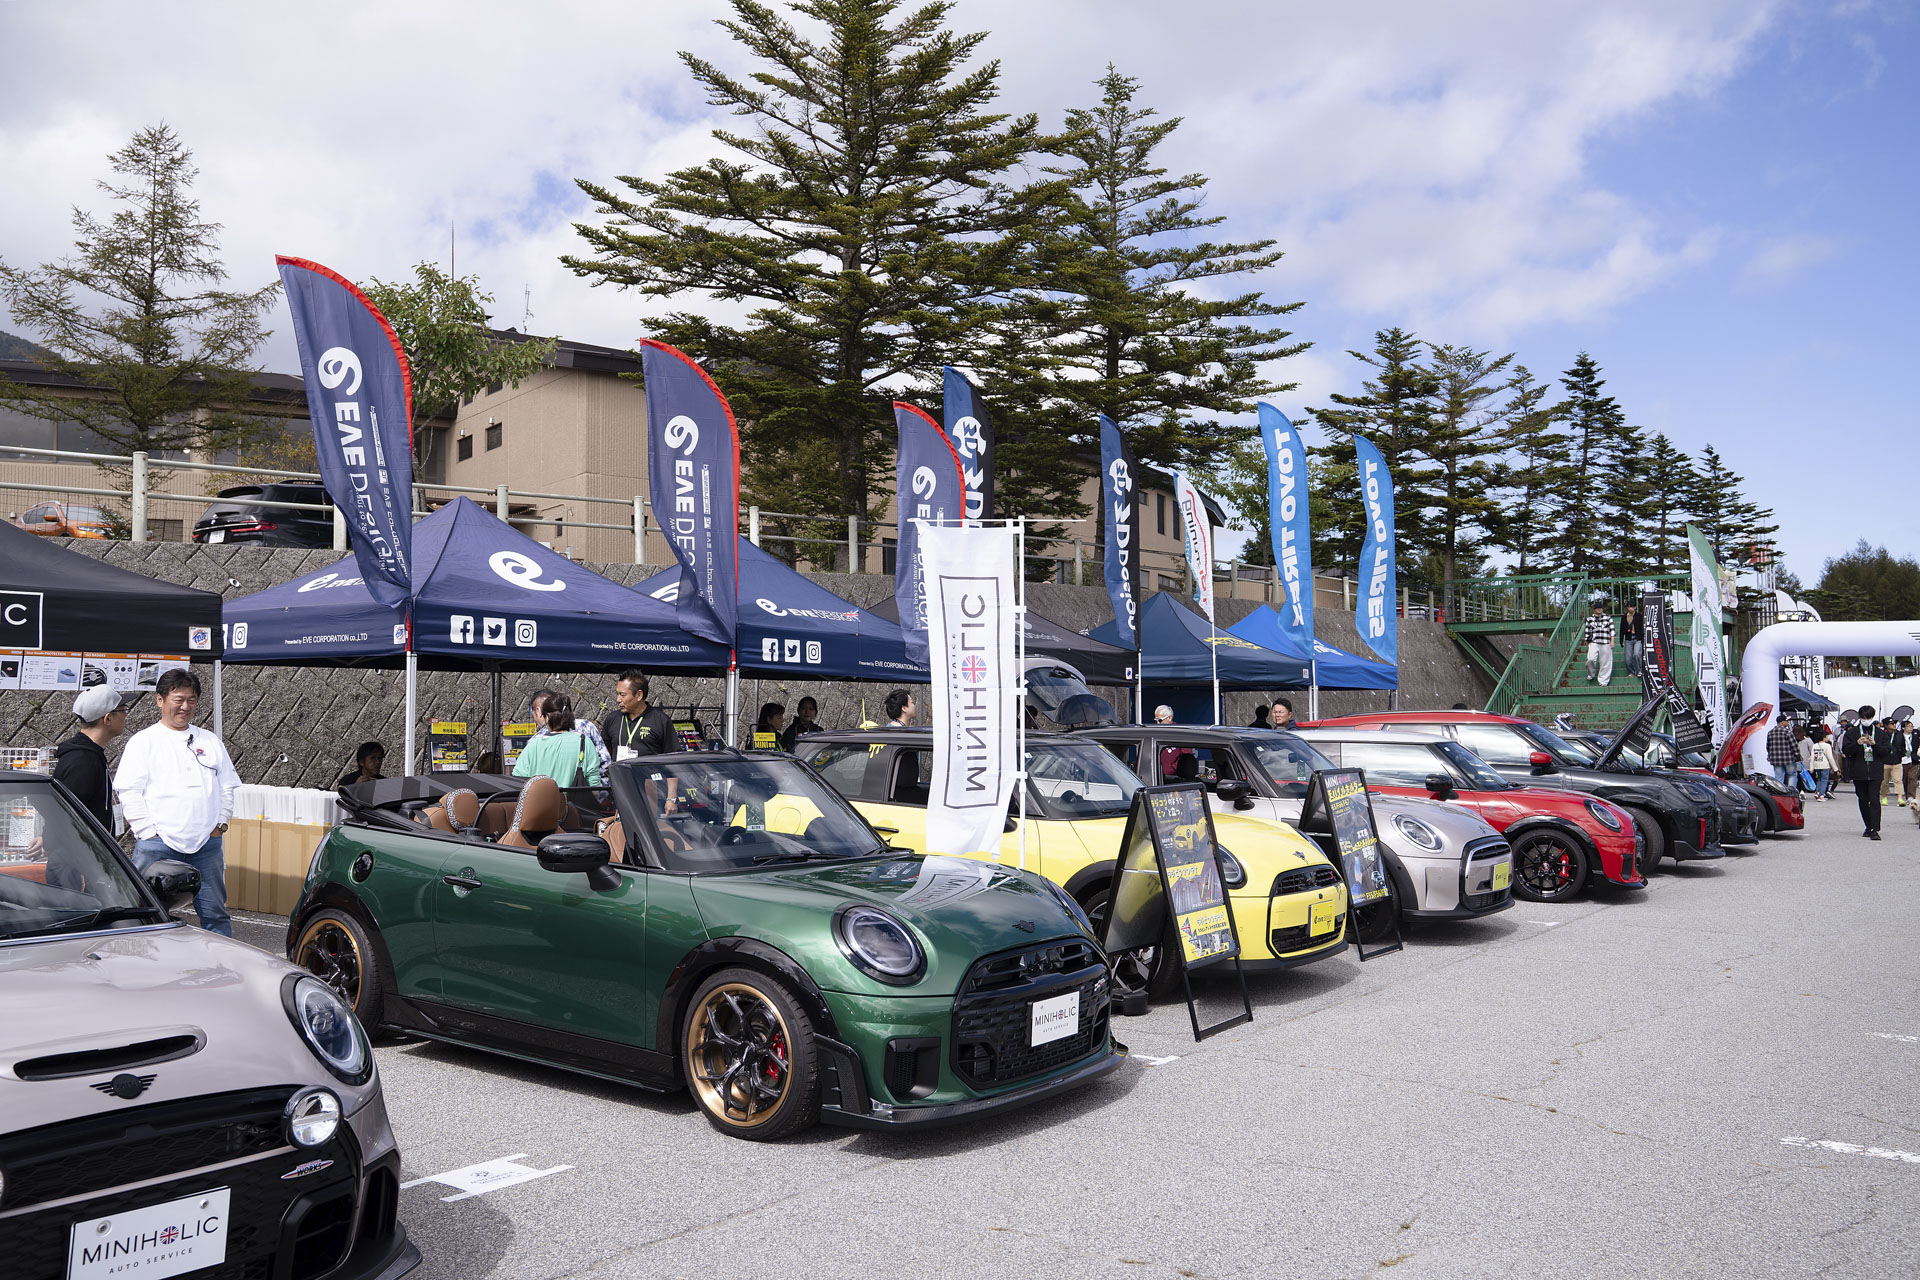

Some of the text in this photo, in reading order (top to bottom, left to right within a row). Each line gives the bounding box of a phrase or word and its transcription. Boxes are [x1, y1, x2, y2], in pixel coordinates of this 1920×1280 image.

[313, 634, 349, 643] CORPORATION
[628, 643, 670, 651] CORPORATION
[884, 661, 913, 670] CORPORATION
[1324, 776, 1338, 788] MINI
[1034, 1006, 1076, 1026] MINIHOLIC
[298, 1162, 322, 1176] WORKS
[82, 1216, 219, 1266] MINIHOLIC
[109, 1248, 193, 1274] AUTO SERVICE
